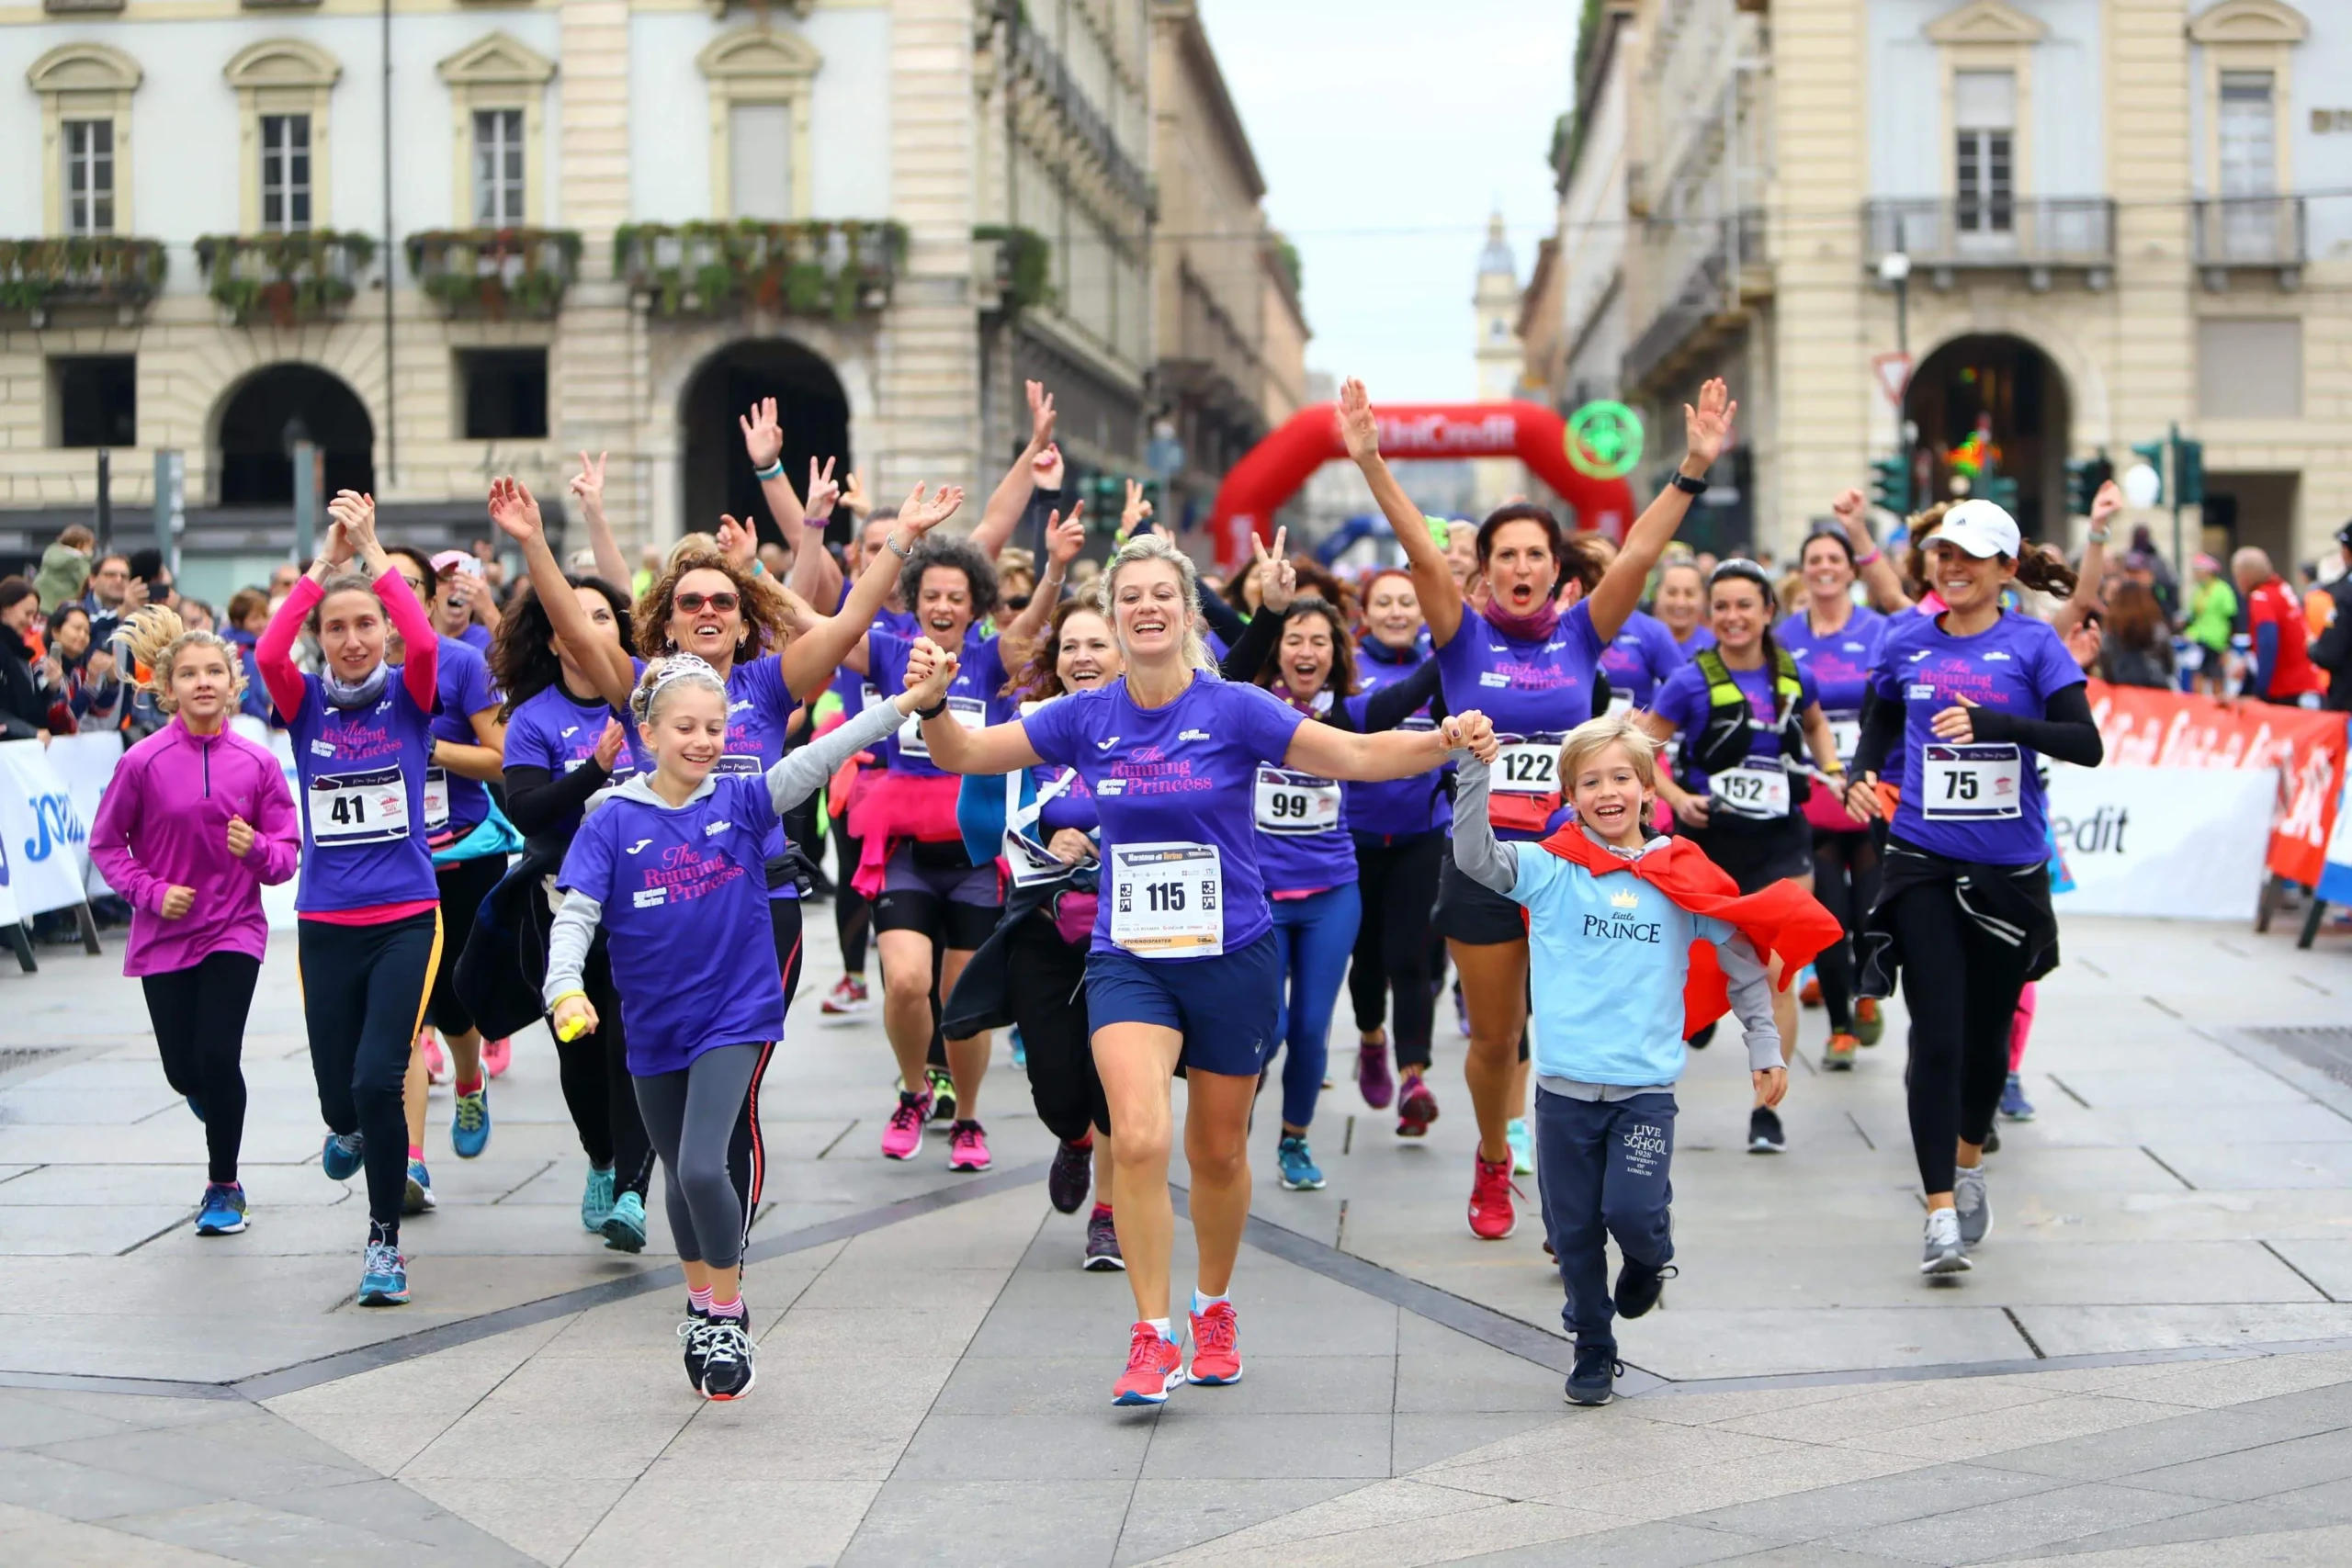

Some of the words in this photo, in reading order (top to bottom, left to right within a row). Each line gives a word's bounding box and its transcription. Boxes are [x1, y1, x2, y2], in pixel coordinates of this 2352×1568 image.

[335, 739, 402, 761] Princess
[1127, 746, 1166, 764] The
[1109, 759, 1192, 779] Running
[1502, 753, 1554, 782] 122
[1126, 777, 1213, 795] Princess
[1722, 775, 1764, 801] 152
[1944, 771, 1979, 800] 75
[332, 795, 366, 825] 41
[1272, 793, 1307, 818] 99
[662, 842, 701, 871] The
[1127, 853, 1155, 862] Maratona
[1163, 852, 1183, 861] Torino
[643, 853, 726, 888] Running
[665, 865, 744, 904] Princess
[1146, 882, 1186, 911] 115
[1611, 911, 1635, 921] Little
[1583, 914, 1661, 943] PRINCE
[1633, 1124, 1662, 1138] LIVE
[1623, 1134, 1668, 1156] SCHOOL
[1635, 1149, 1652, 1158] 1928
[1625, 1155, 1658, 1166] UNIVERSITY
[1627, 1167, 1653, 1177] LONDON
